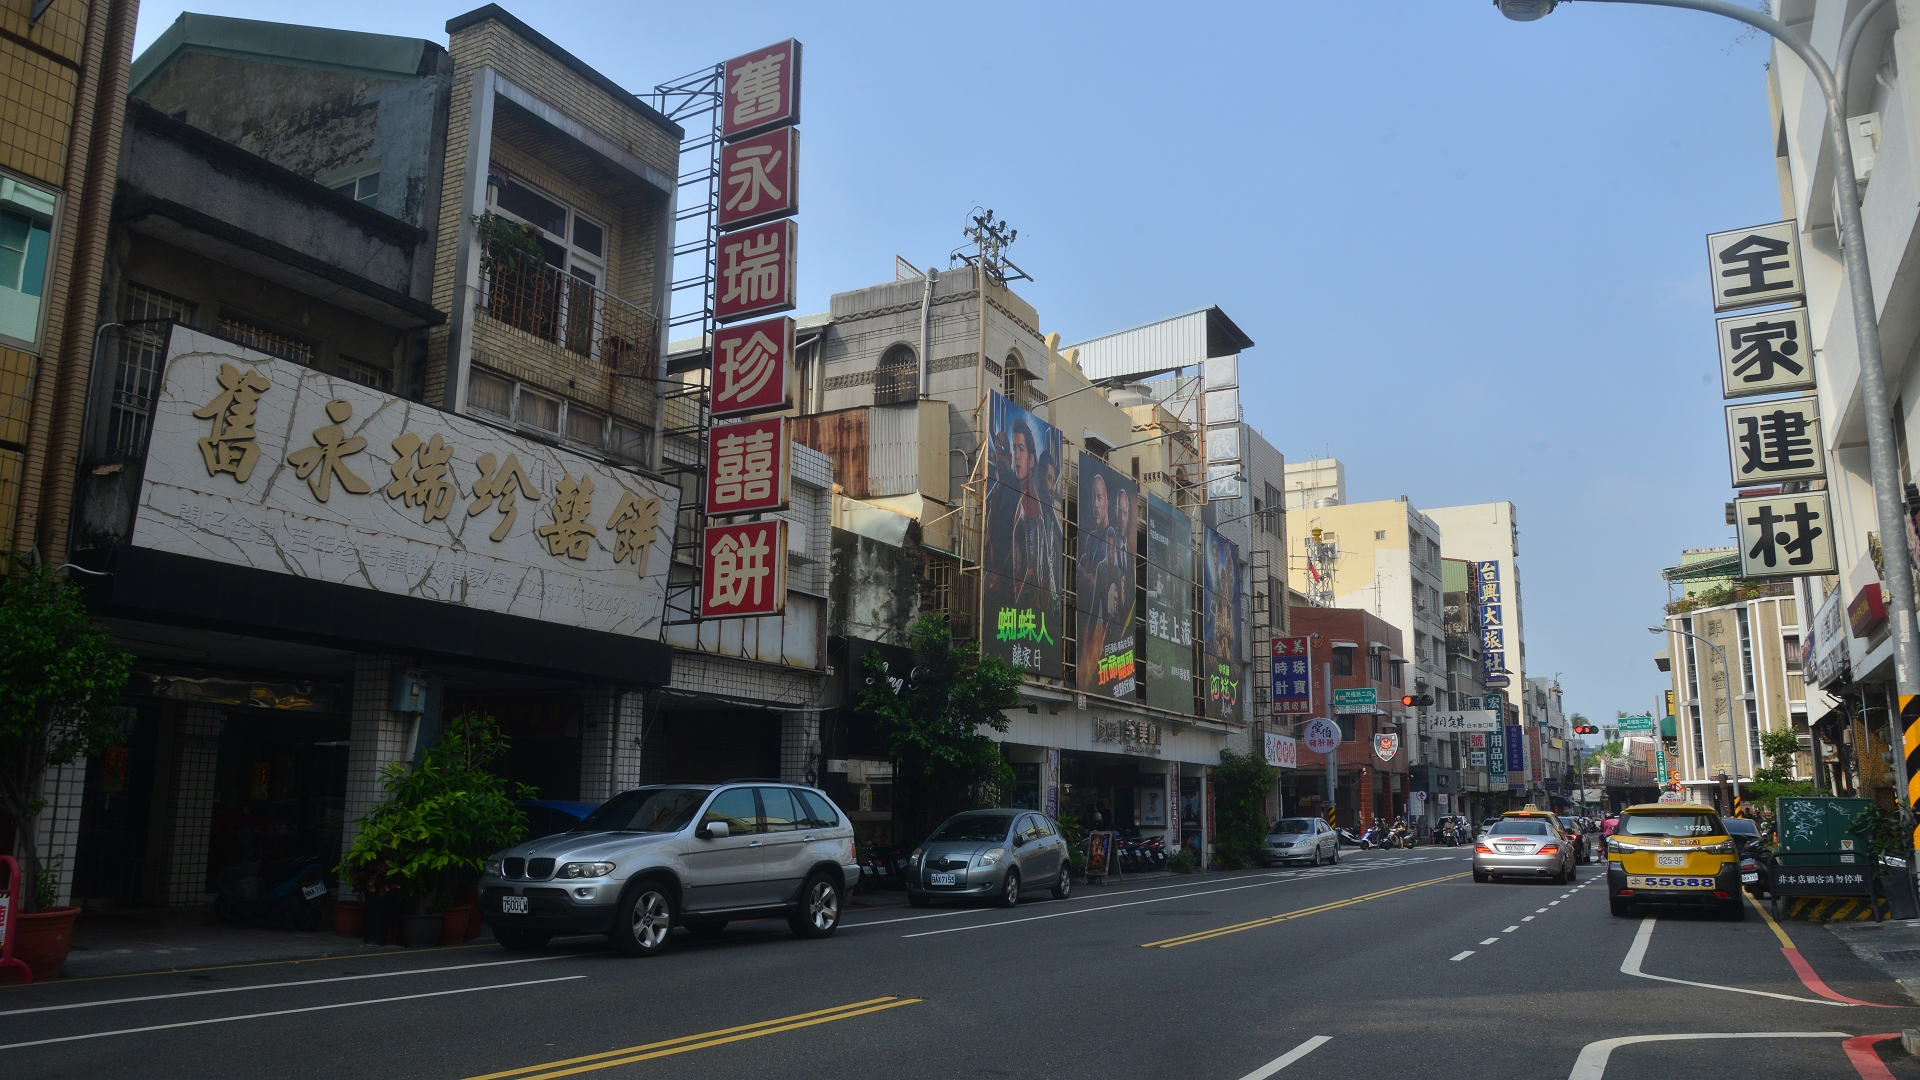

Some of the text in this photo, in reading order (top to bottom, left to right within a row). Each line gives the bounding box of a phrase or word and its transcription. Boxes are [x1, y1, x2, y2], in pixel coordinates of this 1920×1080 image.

[708, 51, 786, 610] 舊永瑞珍囍餅
[192, 362, 662, 579] 舊永瑞珍囍餅
[996, 606, 1054, 646] 蜘蛛人
[1149, 607, 1192, 646] 寄生上流
[1480, 561, 1504, 671] 台興大旅社
[1011, 642, 1042, 671] 離家日
[1274, 639, 1305, 654] 全美
[1098, 649, 1135, 686] 玩命關頭
[1210, 674, 1239, 706] 阿拉丁
[1274, 700, 1308, 712] 高價收購
[1683, 824, 1713, 832] 16265
[1658, 856, 1683, 866] 025-9F
[1644, 877, 1714, 888] 55688
[1777, 874, 1864, 886] 非本店顧客請勿停車
[503, 899, 528, 912] 7500-LW
